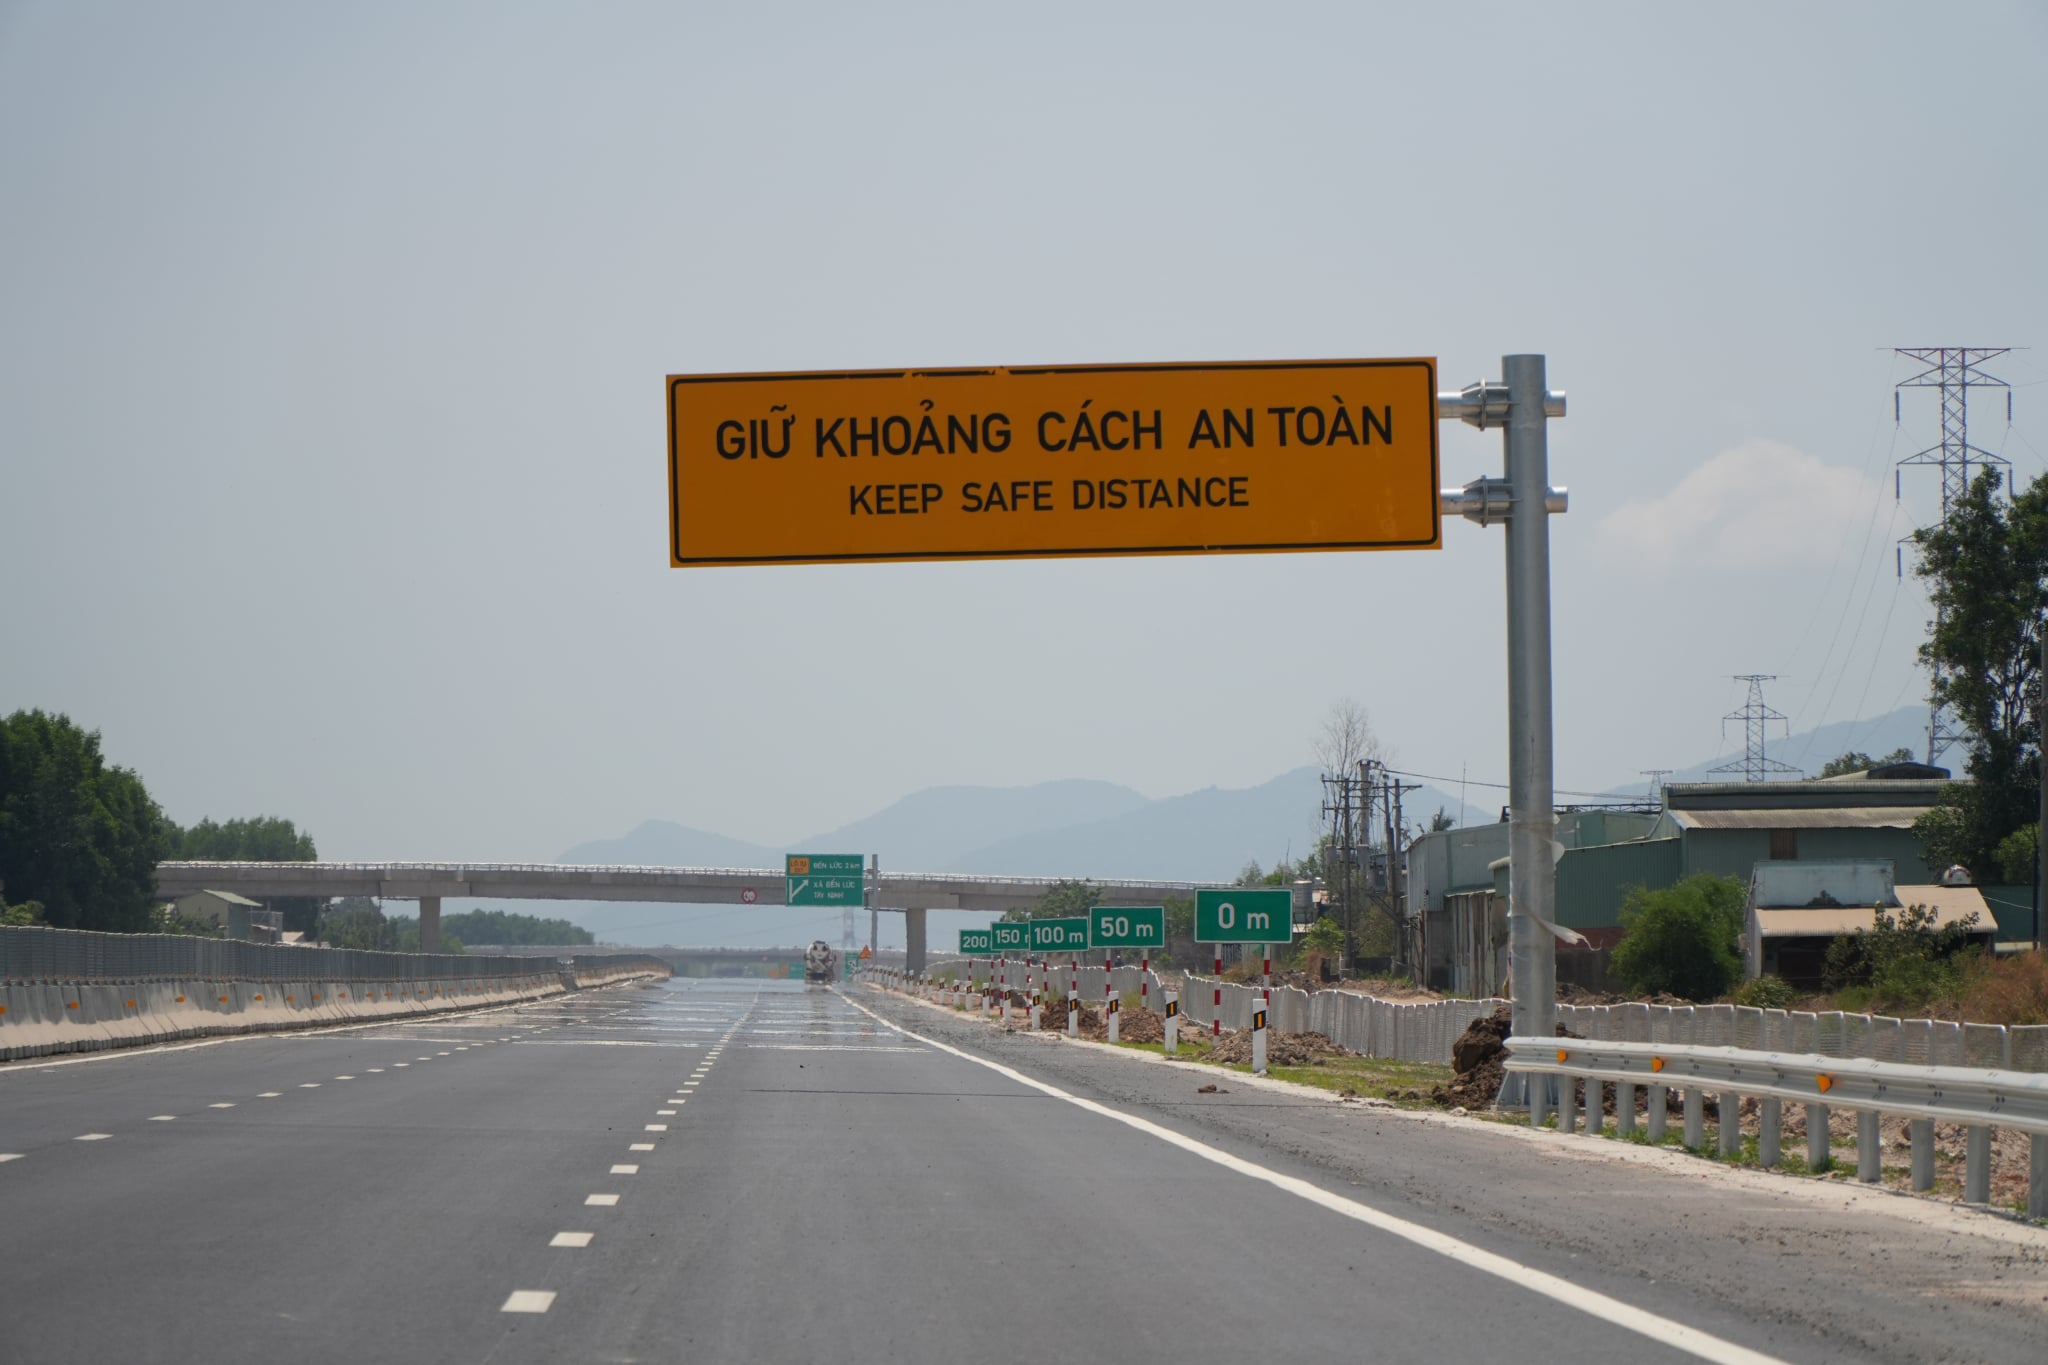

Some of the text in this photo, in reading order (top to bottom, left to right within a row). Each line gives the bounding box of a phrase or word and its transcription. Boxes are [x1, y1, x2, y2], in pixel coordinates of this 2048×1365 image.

[716, 394, 1393, 461] GIỮ KHOẢNG CÁCH AN TOÀN
[849, 476, 1249, 516] KEEP SAFE DISTANCE
[1218, 902, 1270, 929] 0 m
[995, 929, 1020, 944] 150
[1034, 926, 1064, 944] 100
[1069, 932, 1084, 943] m
[1101, 917, 1154, 938] 50 m
[962, 935, 988, 948] 200
